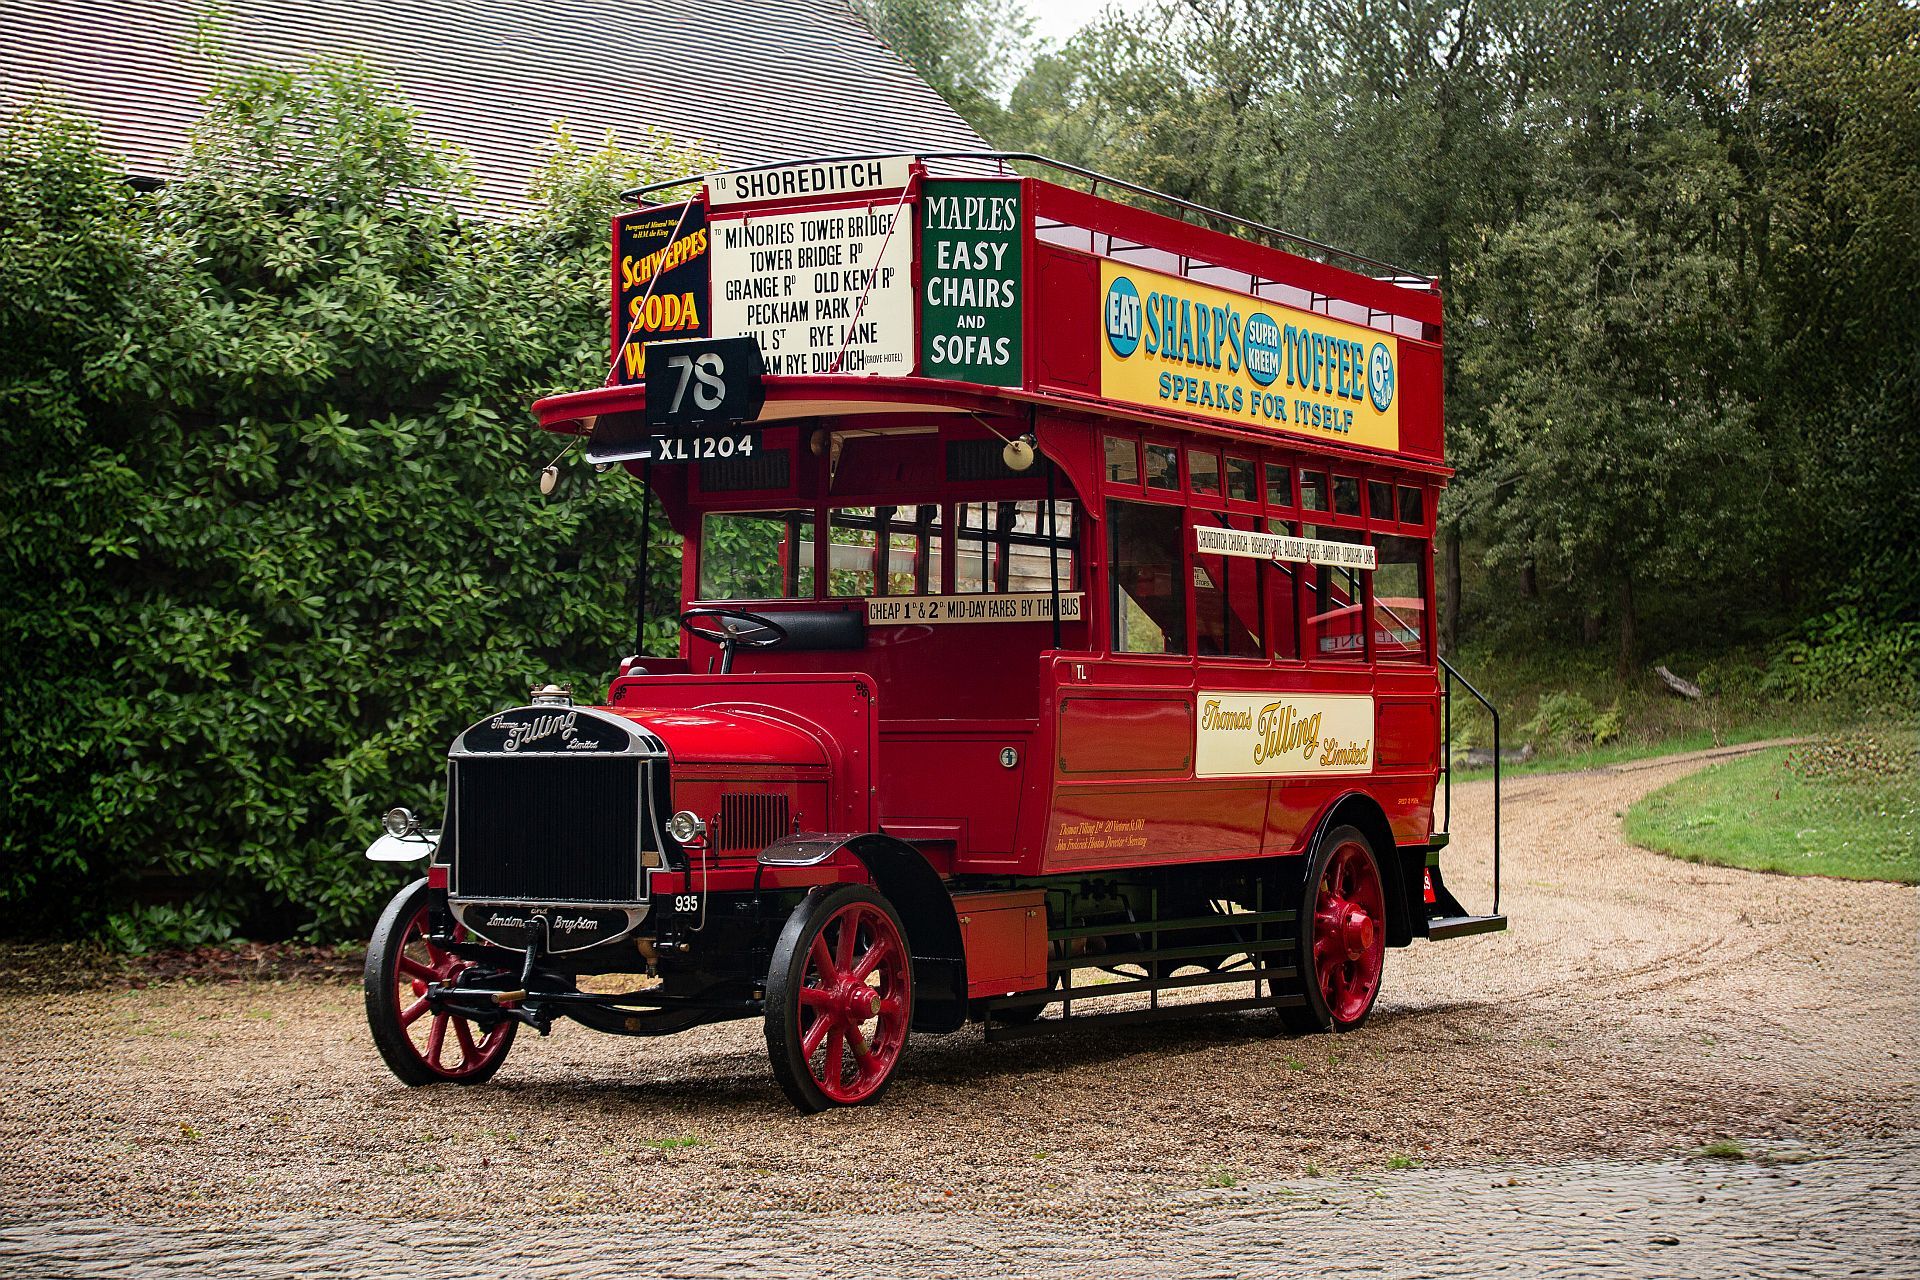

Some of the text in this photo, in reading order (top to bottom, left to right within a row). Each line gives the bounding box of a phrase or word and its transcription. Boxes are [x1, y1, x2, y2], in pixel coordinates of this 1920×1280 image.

[715, 162, 882, 198] TO SHOREDITCH
[926, 196, 1016, 231] MAPLES
[725, 222, 794, 249] MINORIES
[800, 219, 844, 242] TOWER
[848, 214, 894, 238] BRIDGE
[622, 228, 707, 292] SCHWEPPES
[750, 249, 793, 272] TOWER
[798, 244, 842, 269] BRIDGE
[937, 241, 1009, 271] EASY
[725, 276, 779, 301] GRANGE
[814, 271, 839, 293] OLD
[843, 269, 878, 292] KENT
[927, 276, 1015, 308] CHAIRS
[628, 292, 700, 333] SODA
[747, 300, 809, 326] PECKHAM
[815, 297, 850, 320] PARK
[957, 315, 986, 329] AND
[809, 325, 834, 348] RYE
[840, 322, 878, 346] LANE
[1109, 291, 1242, 373] EAT SHARP'S
[1249, 320, 1277, 349] SUPER
[786, 353, 807, 374] RYE
[931, 334, 1011, 365] SOFAS
[1248, 349, 1278, 377] KREEM
[1283, 322, 1364, 400] TOFFEE
[667, 352, 726, 413] 78
[1158, 371, 1353, 434] SPEAKS FOR ITSELF
[1198, 530, 1228, 551] SHOREDITCH
[1228, 533, 1248, 553] CHURCH
[1251, 536, 1282, 556] BISHOPSGATE
[1284, 540, 1305, 559] ALDGATE
[1363, 549, 1374, 565] LANE
[870, 602, 900, 620] CHEAP
[918, 604, 925, 618] &
[947, 600, 986, 618] MID-DAY
[988, 599, 1016, 618] FARES
[1021, 599, 1033, 617] BY
[1037, 598, 1053, 616] THI
[1061, 598, 1079, 616] BUS
[1076, 664, 1087, 680] TL
[503, 711, 578, 752] Tilling
[566, 738, 599, 750] Limited
[1202, 699, 1370, 767] Thomas Tilling Limited
[1055, 838, 1066, 852] John
[1066, 837, 1088, 851] Frederick
[1059, 823, 1078, 835] Thomas
[675, 895, 698, 912] 935
[486, 912, 524, 928] London
